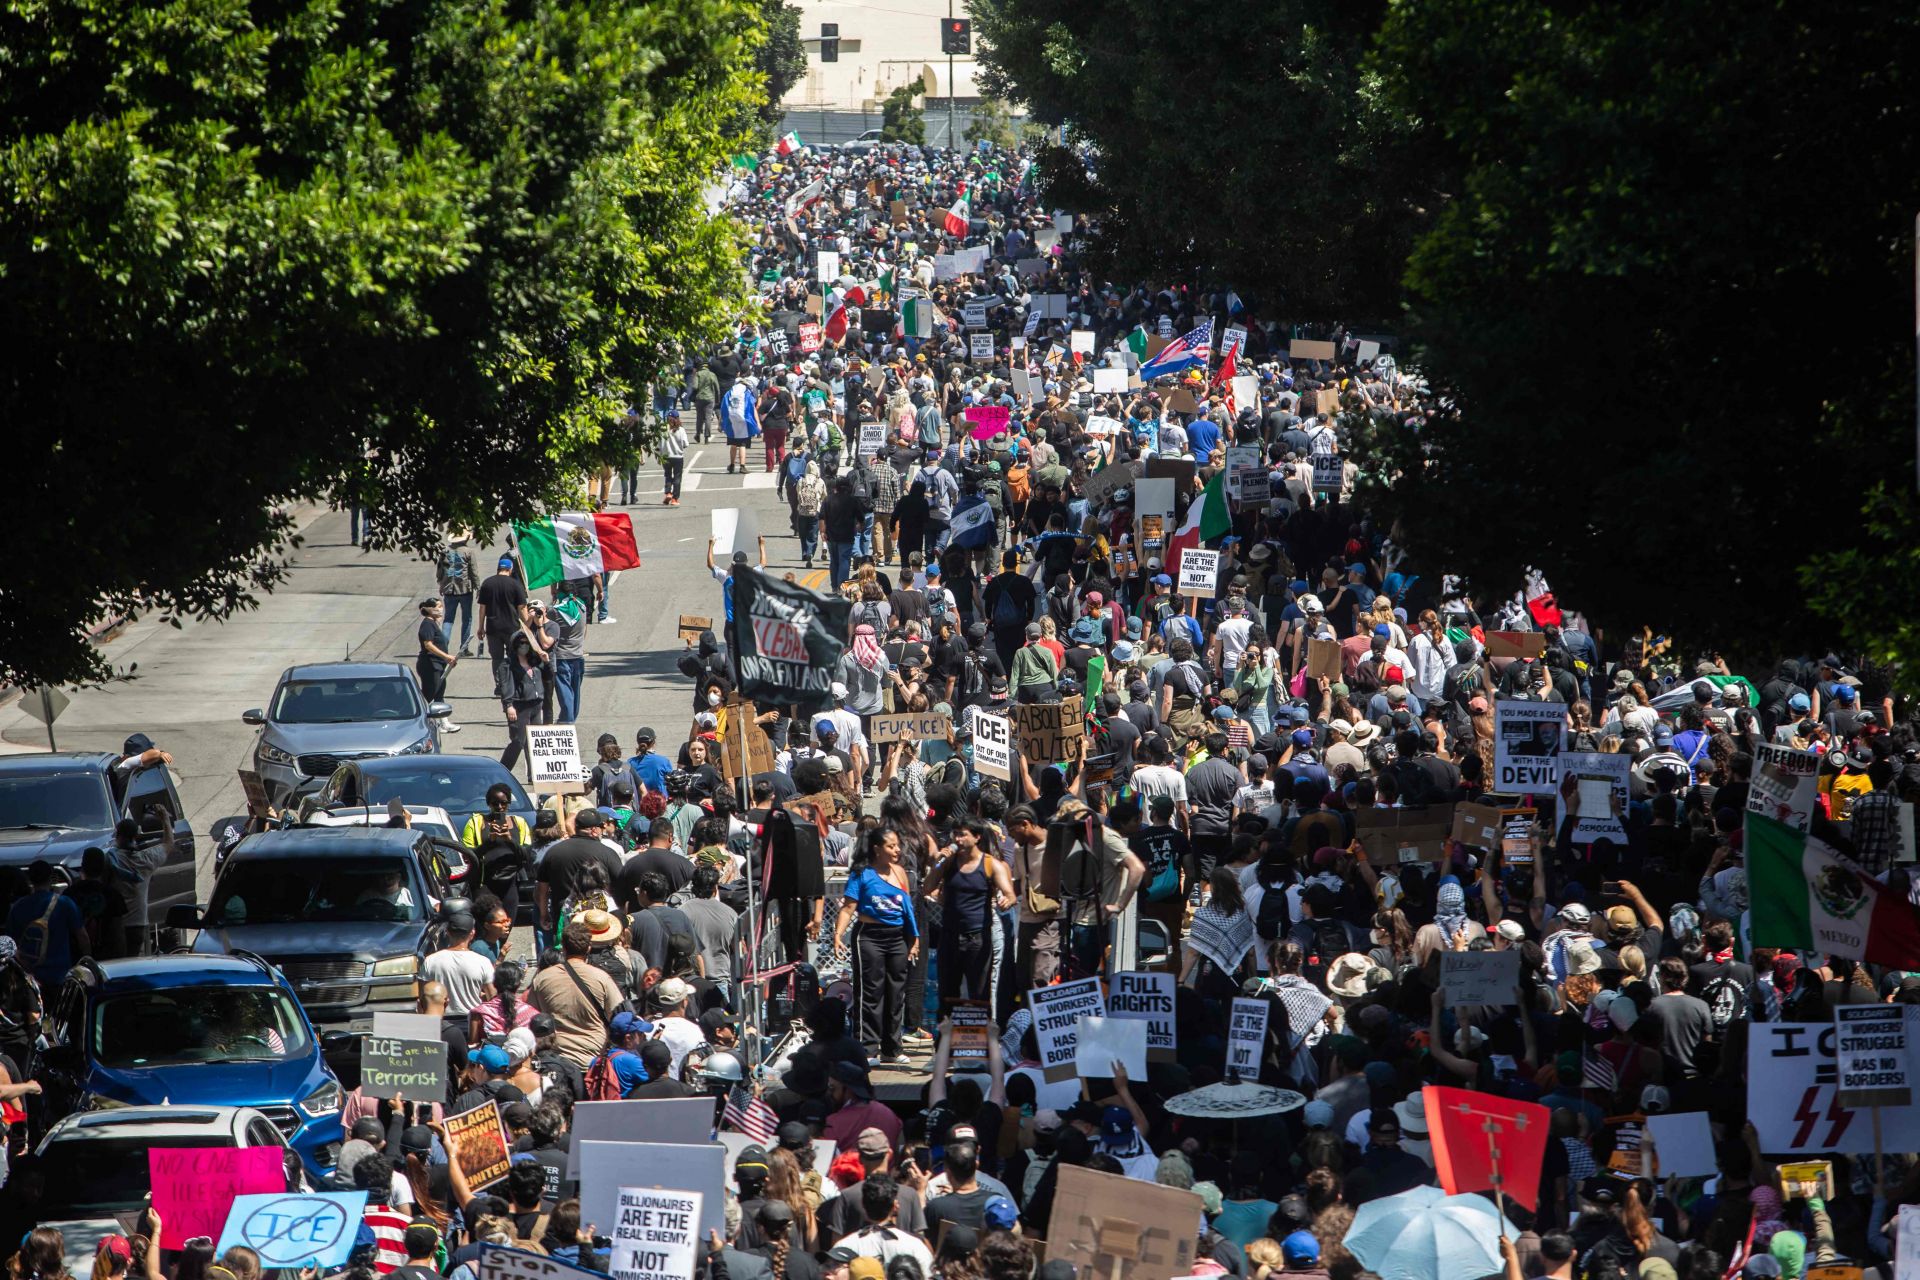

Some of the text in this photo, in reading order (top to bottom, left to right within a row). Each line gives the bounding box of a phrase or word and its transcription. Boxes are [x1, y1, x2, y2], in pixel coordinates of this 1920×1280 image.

[768, 328, 787, 342] FUCK
[1225, 336, 1245, 344] RIGHS
[771, 340, 790, 356] ICE
[1315, 456, 1342, 471] ICE:
[1242, 478, 1268, 486] PLENOS
[1184, 551, 1217, 559] BILLIONAIRES
[1184, 557, 1214, 566] ARE THE
[1189, 574, 1206, 582] NOT
[1019, 704, 1084, 735] ABOLISH
[1500, 709, 1565, 719] YOU MADE A DEAL
[531, 730, 574, 738] BILLIONAIRES
[975, 715, 1006, 745] ICE:
[534, 737, 574, 748] ARE THE
[533, 748, 577, 757] REAL ENEMY,
[975, 744, 1008, 761] OUT OF OUR
[975, 752, 1008, 767] COMMUNITIES!
[1757, 745, 1819, 772] FREEDOM
[546, 761, 568, 773] NOT
[1512, 757, 1550, 766] WITH THE
[536, 773, 580, 781] IMMIGRANTS!
[1502, 766, 1557, 784] DEVIL
[1040, 984, 1090, 1001] SOLIDARITY!
[1121, 976, 1162, 994] FULL
[1046, 994, 1099, 1014] WORKERS'
[1111, 995, 1173, 1013] RIGHTS
[1147, 1021, 1173, 1036] ALL
[1247, 1016, 1264, 1030] THE
[1851, 1022, 1904, 1034] WORKERS'
[1053, 1033, 1077, 1047] HAS
[1771, 1027, 1836, 1057] IC
[1840, 1036, 1905, 1051] STRUGGLE
[368, 1039, 440, 1057] ICE are the
[388, 1056, 413, 1067] Real
[1233, 1048, 1251, 1065] NOT
[1852, 1058, 1896, 1071] HAS NO
[361, 1068, 439, 1086] Terrorist
[1844, 1072, 1905, 1087] BORDERS!
[447, 1104, 496, 1134] BLACK
[450, 1118, 499, 1146] BROWN
[156, 1153, 184, 1176] NO
[192, 1152, 236, 1176] ONE
[464, 1160, 510, 1188] UNITED
[620, 1195, 694, 1211] BILLIONAIRES
[249, 1212, 336, 1243] ICE
[620, 1210, 689, 1230] ARE THE
[616, 1227, 692, 1247] REAL ENEMY,
[489, 1252, 558, 1275] STOP
[631, 1251, 669, 1271] NOT
[612, 1270, 687, 1280] IMMIGRANTS!
